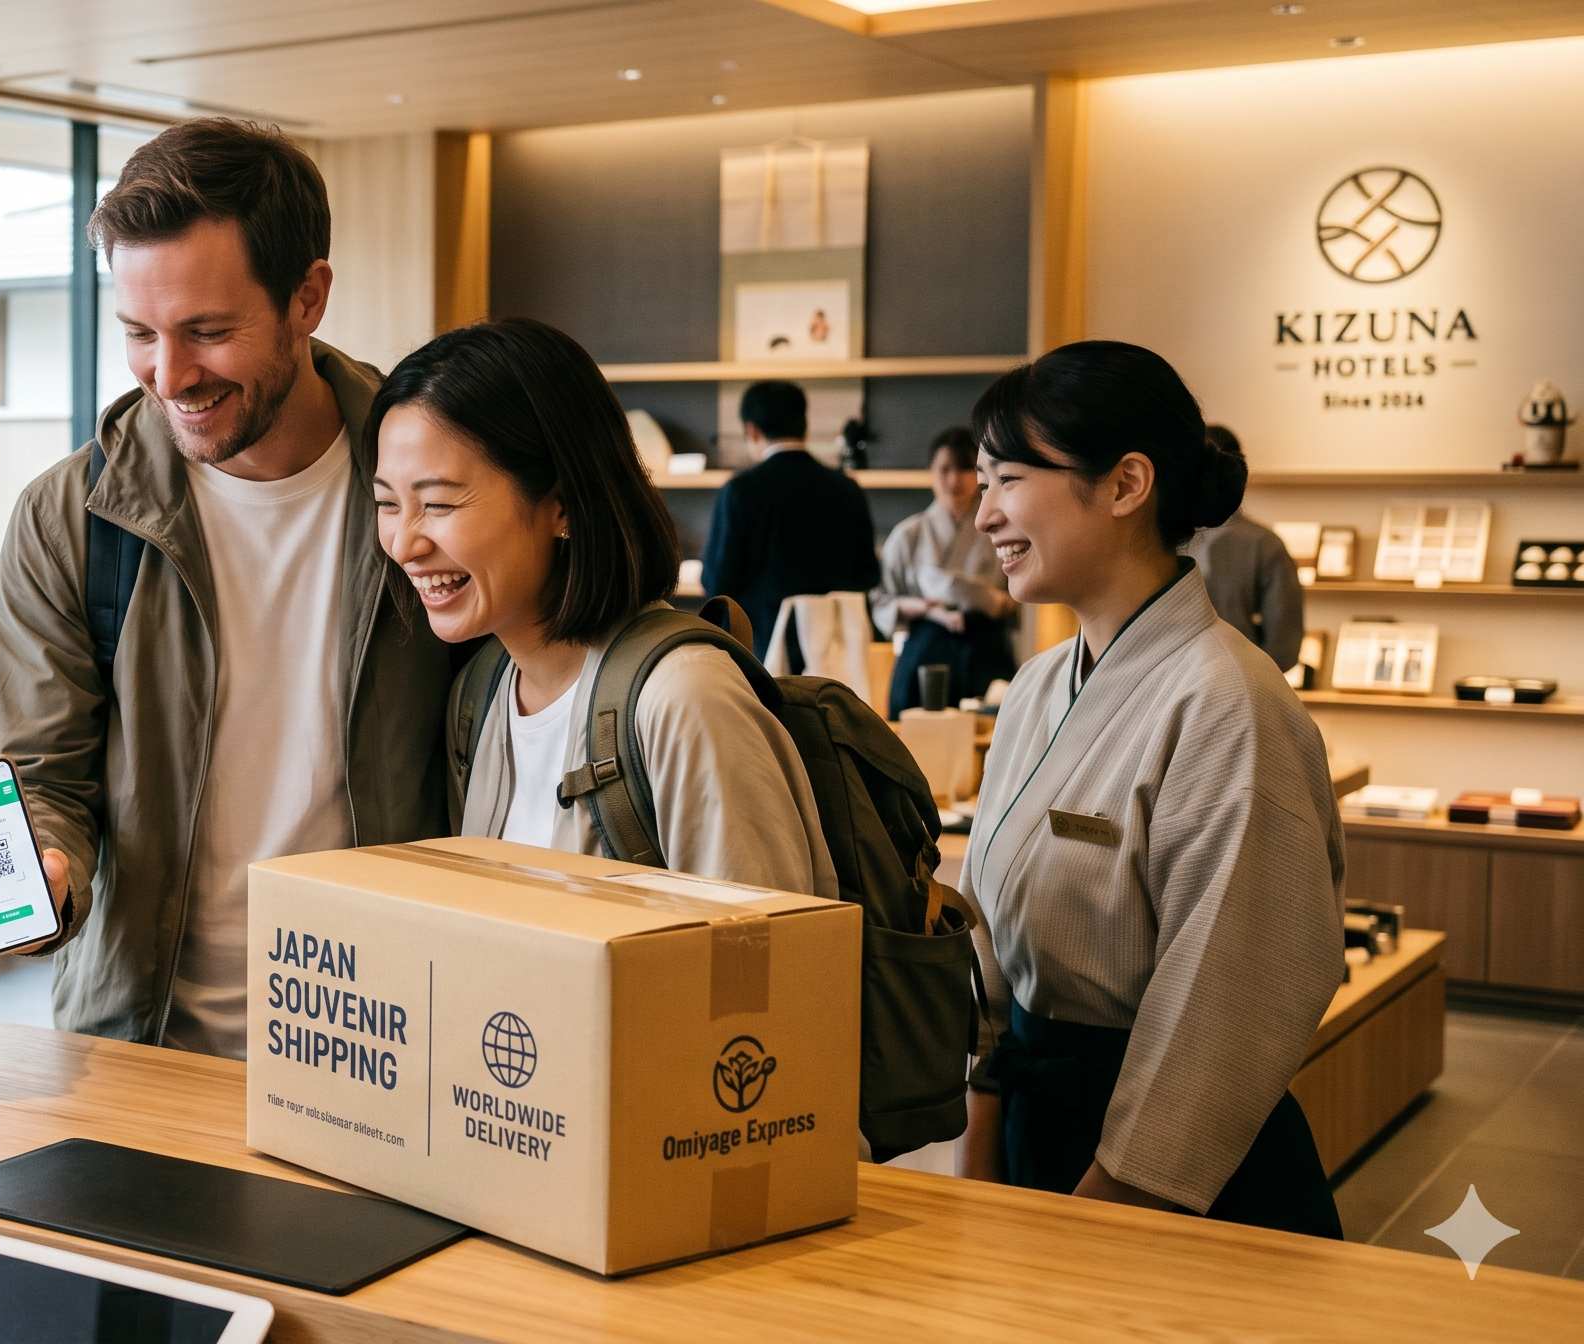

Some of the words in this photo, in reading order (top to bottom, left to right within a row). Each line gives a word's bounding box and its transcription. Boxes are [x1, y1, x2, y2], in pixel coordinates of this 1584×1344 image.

[1275, 309, 1478, 345] KIZUNA
[1313, 356, 1436, 379] HOTELS
[268, 928, 356, 982] JAPAN
[268, 973, 407, 1045] SOUVENIR
[267, 1020, 398, 1091] SHIPPING
[453, 1085, 566, 1137] WORLDWIDE
[466, 1117, 551, 1162] DELIVERY
[663, 1130, 742, 1161] Omiyage
[747, 1112, 815, 1145] Express
